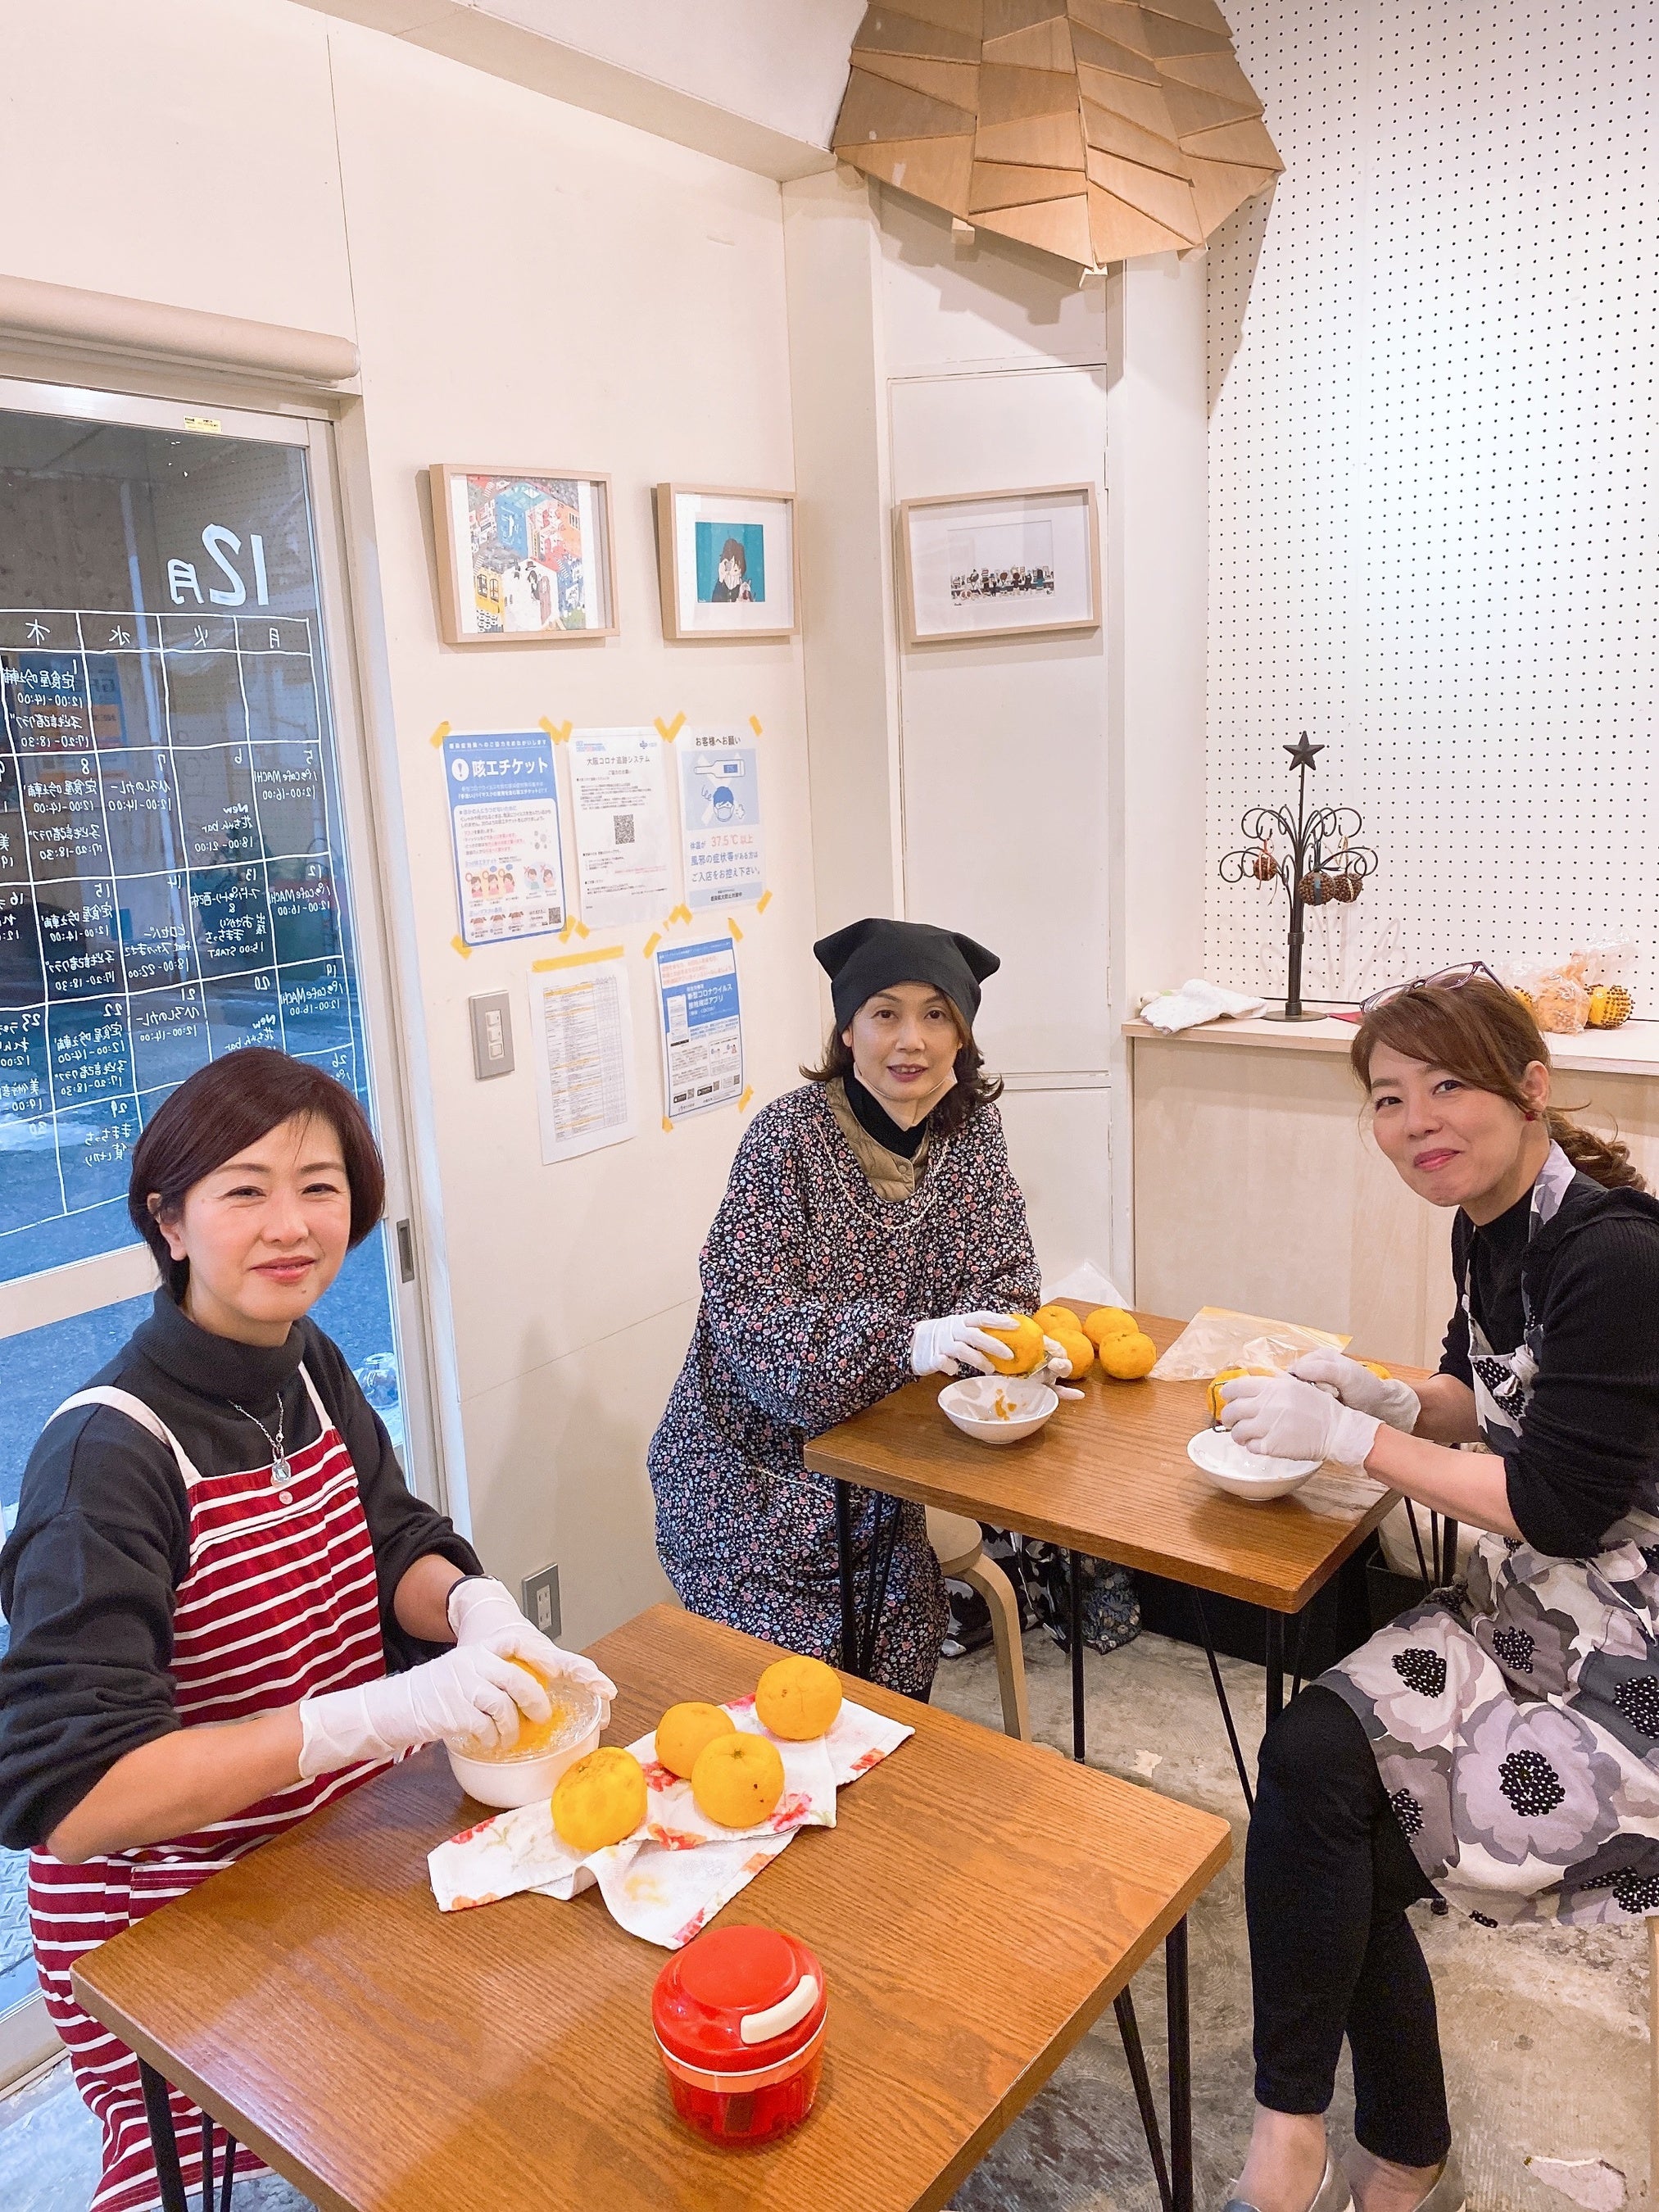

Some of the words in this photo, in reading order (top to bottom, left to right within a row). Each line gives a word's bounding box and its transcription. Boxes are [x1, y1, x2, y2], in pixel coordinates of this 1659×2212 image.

[696, 736, 741, 747] お客様へお願い
[587, 755, 650, 766] 大阪コロナ追跡システム
[471, 757, 549, 778] 咳エチケット
[690, 841, 706, 850] 体温が
[691, 851, 758, 866] 風邪の症状等がある方は
[687, 984, 732, 999] 新型コロナウイルス
